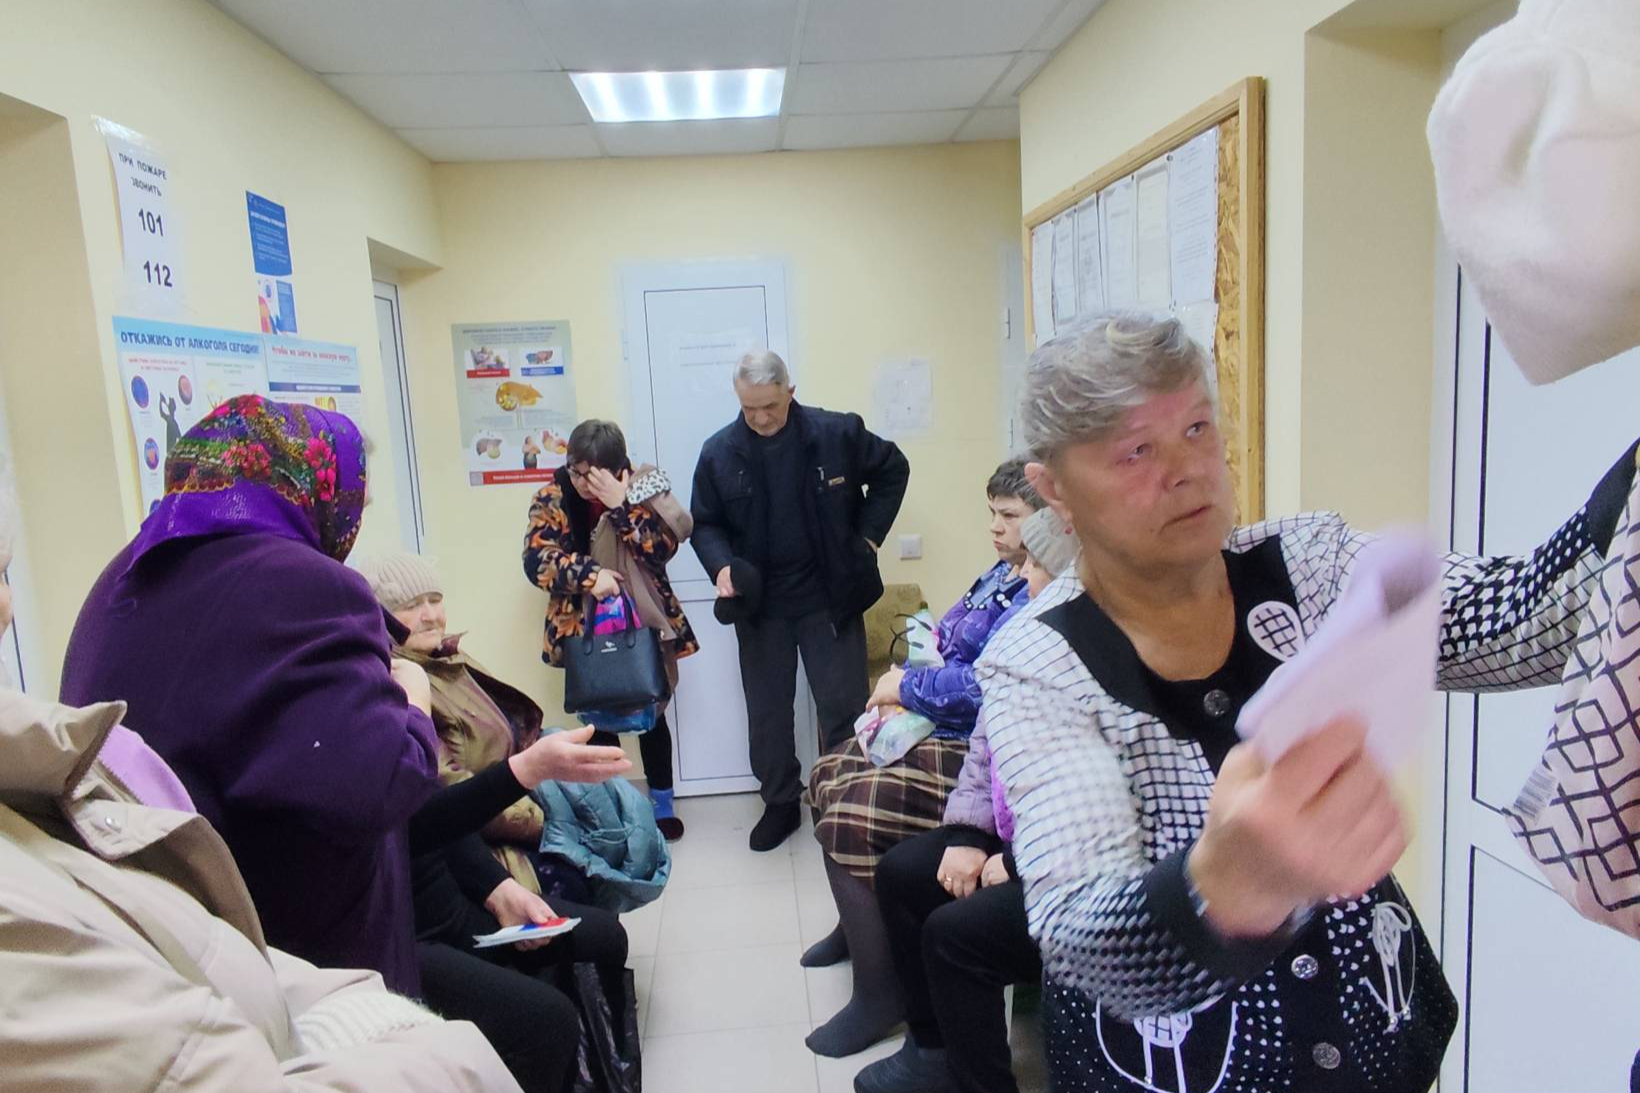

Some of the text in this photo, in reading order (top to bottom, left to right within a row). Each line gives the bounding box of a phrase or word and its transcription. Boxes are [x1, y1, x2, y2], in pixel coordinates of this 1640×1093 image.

[118, 152, 167, 180] ПРИ ПОЖАРЕ
[131, 177, 162, 197] ЗВОНИТЬ
[138, 207, 164, 237] 101
[143, 260, 173, 288] 112
[120, 331, 173, 347] ОТКАЖИСЬ
[174, 337, 186, 348] ОТ
[188, 338, 229, 352] АЛКОГОЛЯ
